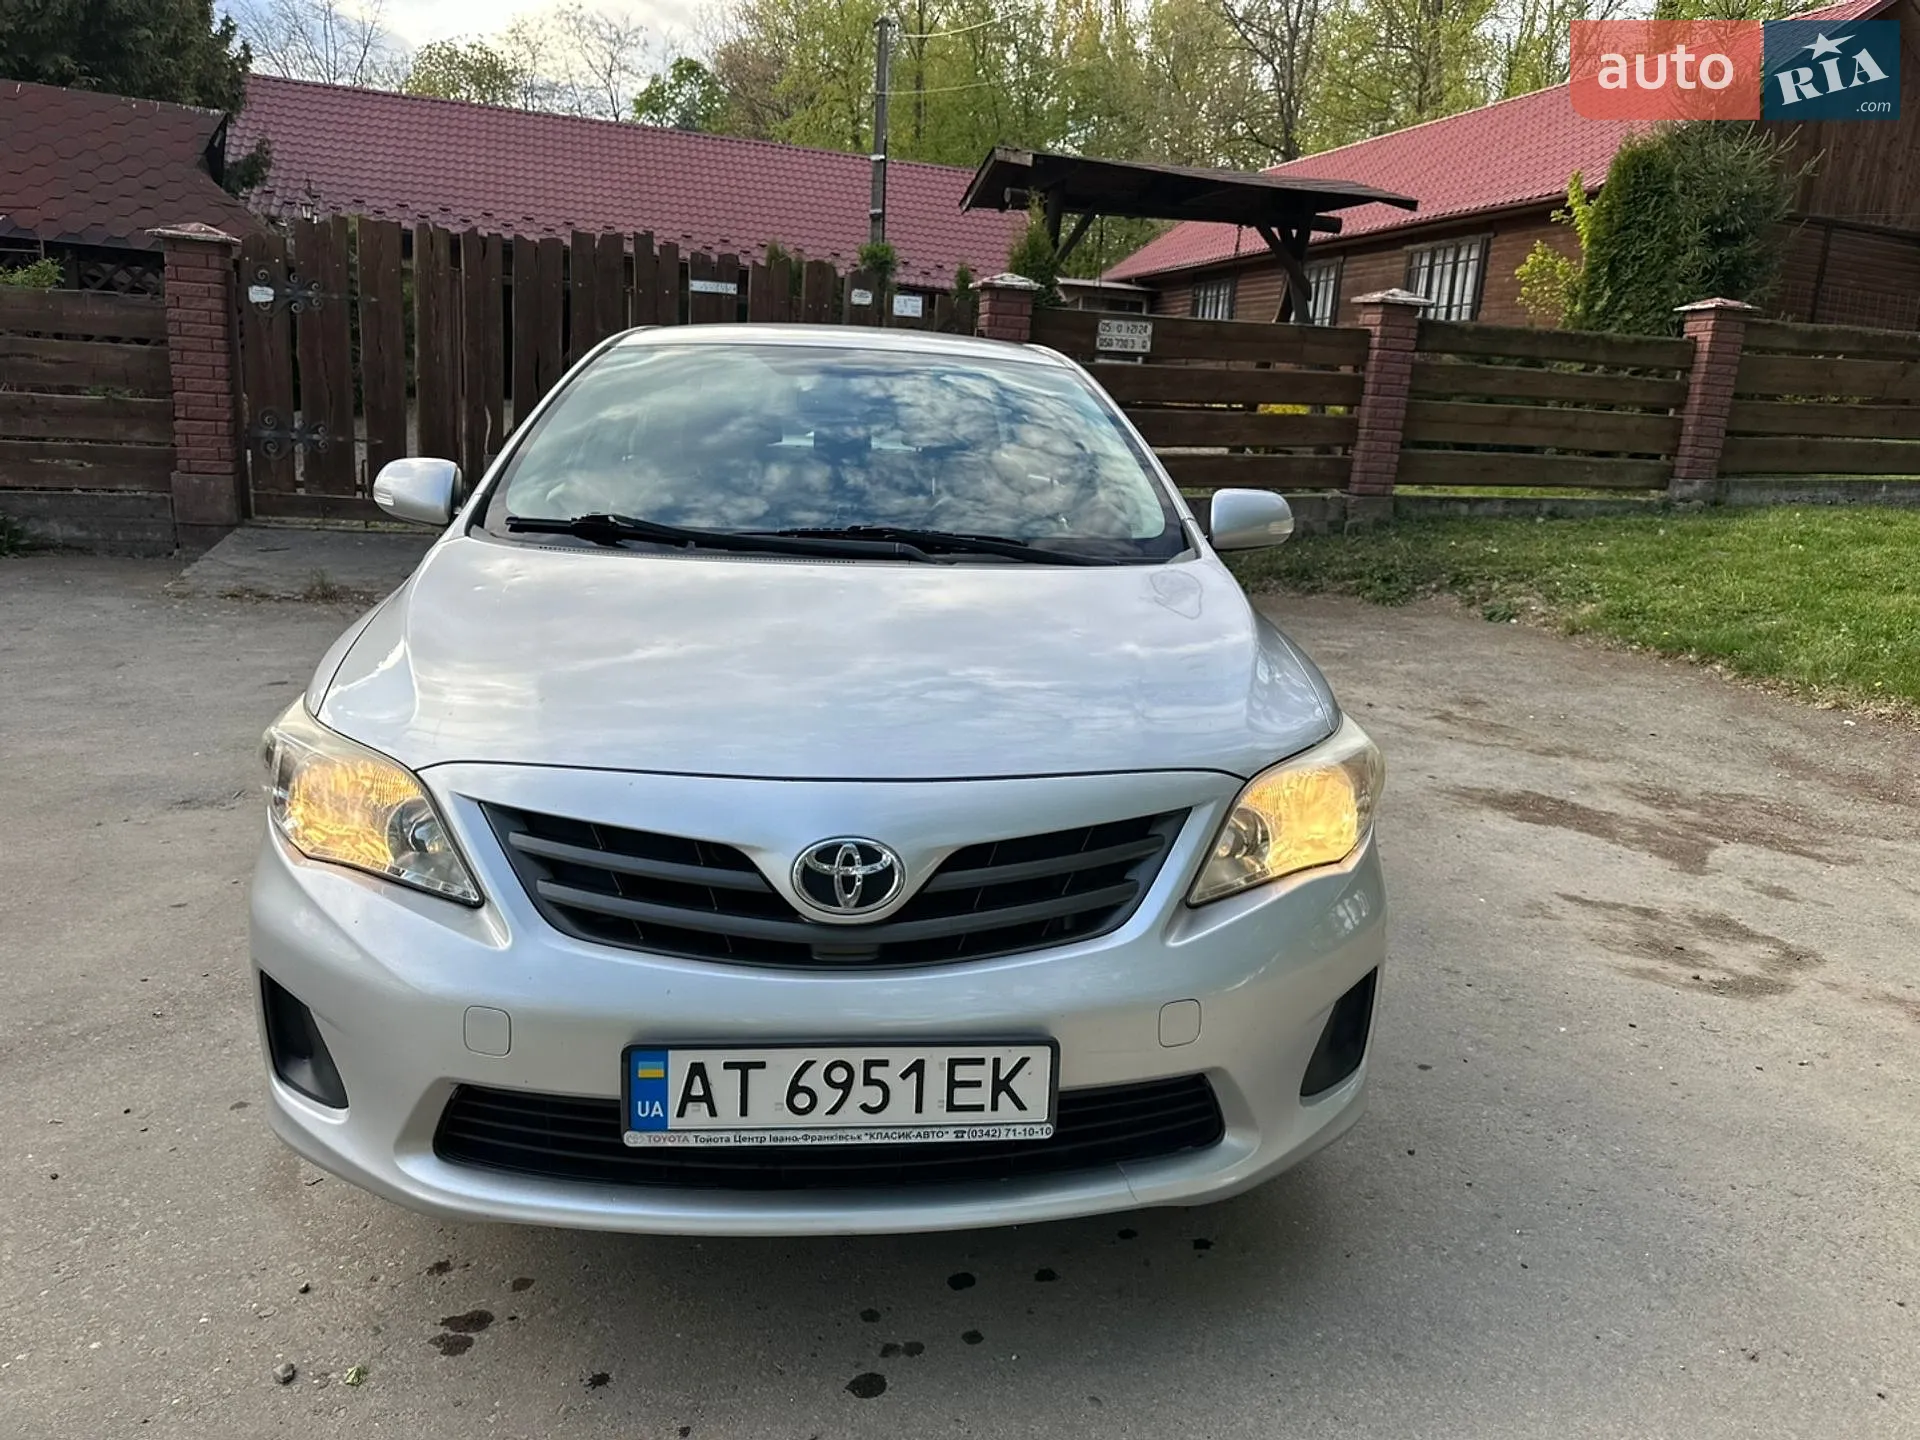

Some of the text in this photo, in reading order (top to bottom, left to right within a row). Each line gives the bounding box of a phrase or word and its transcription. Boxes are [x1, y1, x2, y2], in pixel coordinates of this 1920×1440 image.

[676, 1056, 1032, 1118] AT 6951 EK
[637, 1101, 664, 1118] UA
[646, 1134, 690, 1144] TOYOTA
[733, 1133, 767, 1144] Центр
